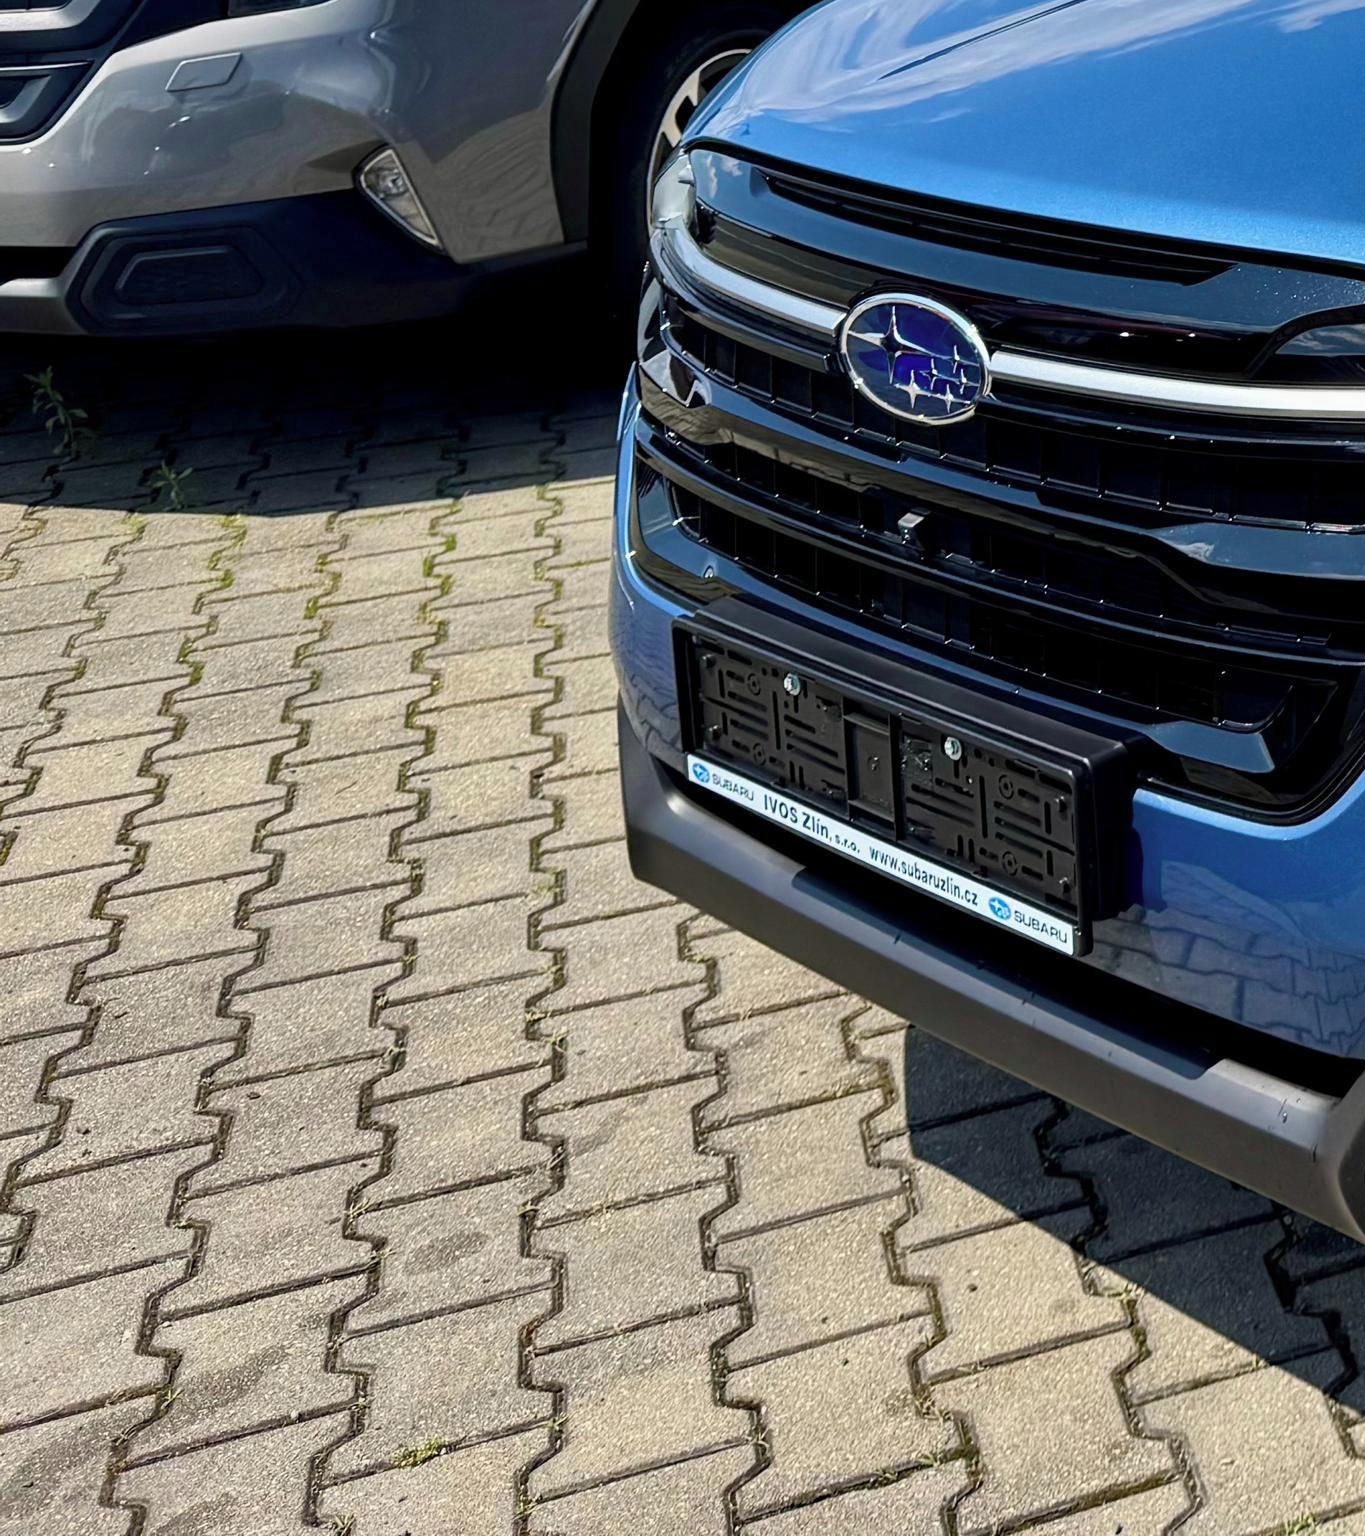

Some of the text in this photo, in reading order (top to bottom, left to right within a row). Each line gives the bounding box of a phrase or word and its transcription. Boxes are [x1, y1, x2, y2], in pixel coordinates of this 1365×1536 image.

[712, 773, 755, 801] SUBARU
[763, 794, 799, 824] IVOS
[834, 834, 861, 854] s.r.o.
[868, 846, 979, 907] www.subaruzlin.cz
[1014, 910, 1068, 944] SUBARU
